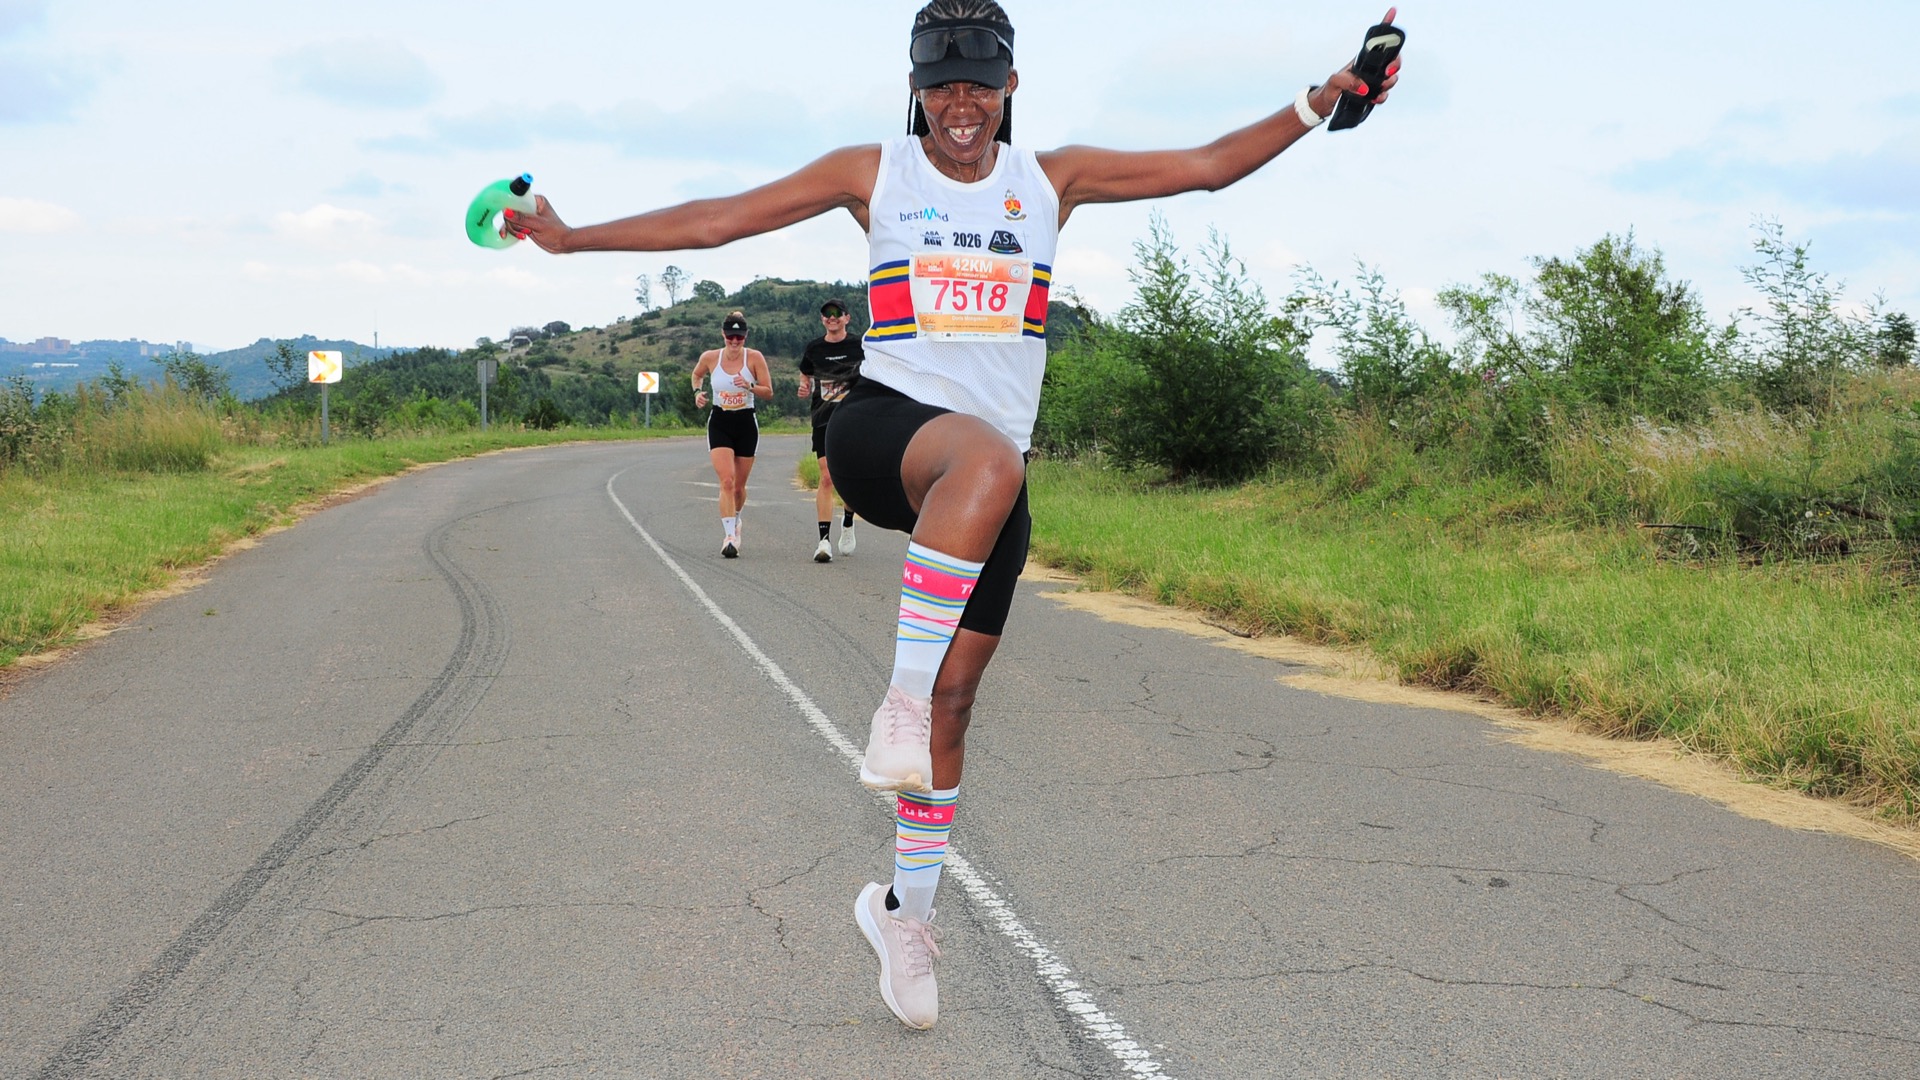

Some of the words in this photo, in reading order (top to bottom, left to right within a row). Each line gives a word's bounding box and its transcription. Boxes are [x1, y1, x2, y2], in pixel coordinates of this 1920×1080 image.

[899, 207, 949, 222] bestMd
[952, 231, 982, 248] 2026
[992, 232, 1018, 246] ASA
[952, 258, 993, 274] 42KM
[930, 279, 1009, 312] 7518
[723, 397, 743, 405] 7506
[898, 802, 943, 820] Tuks
